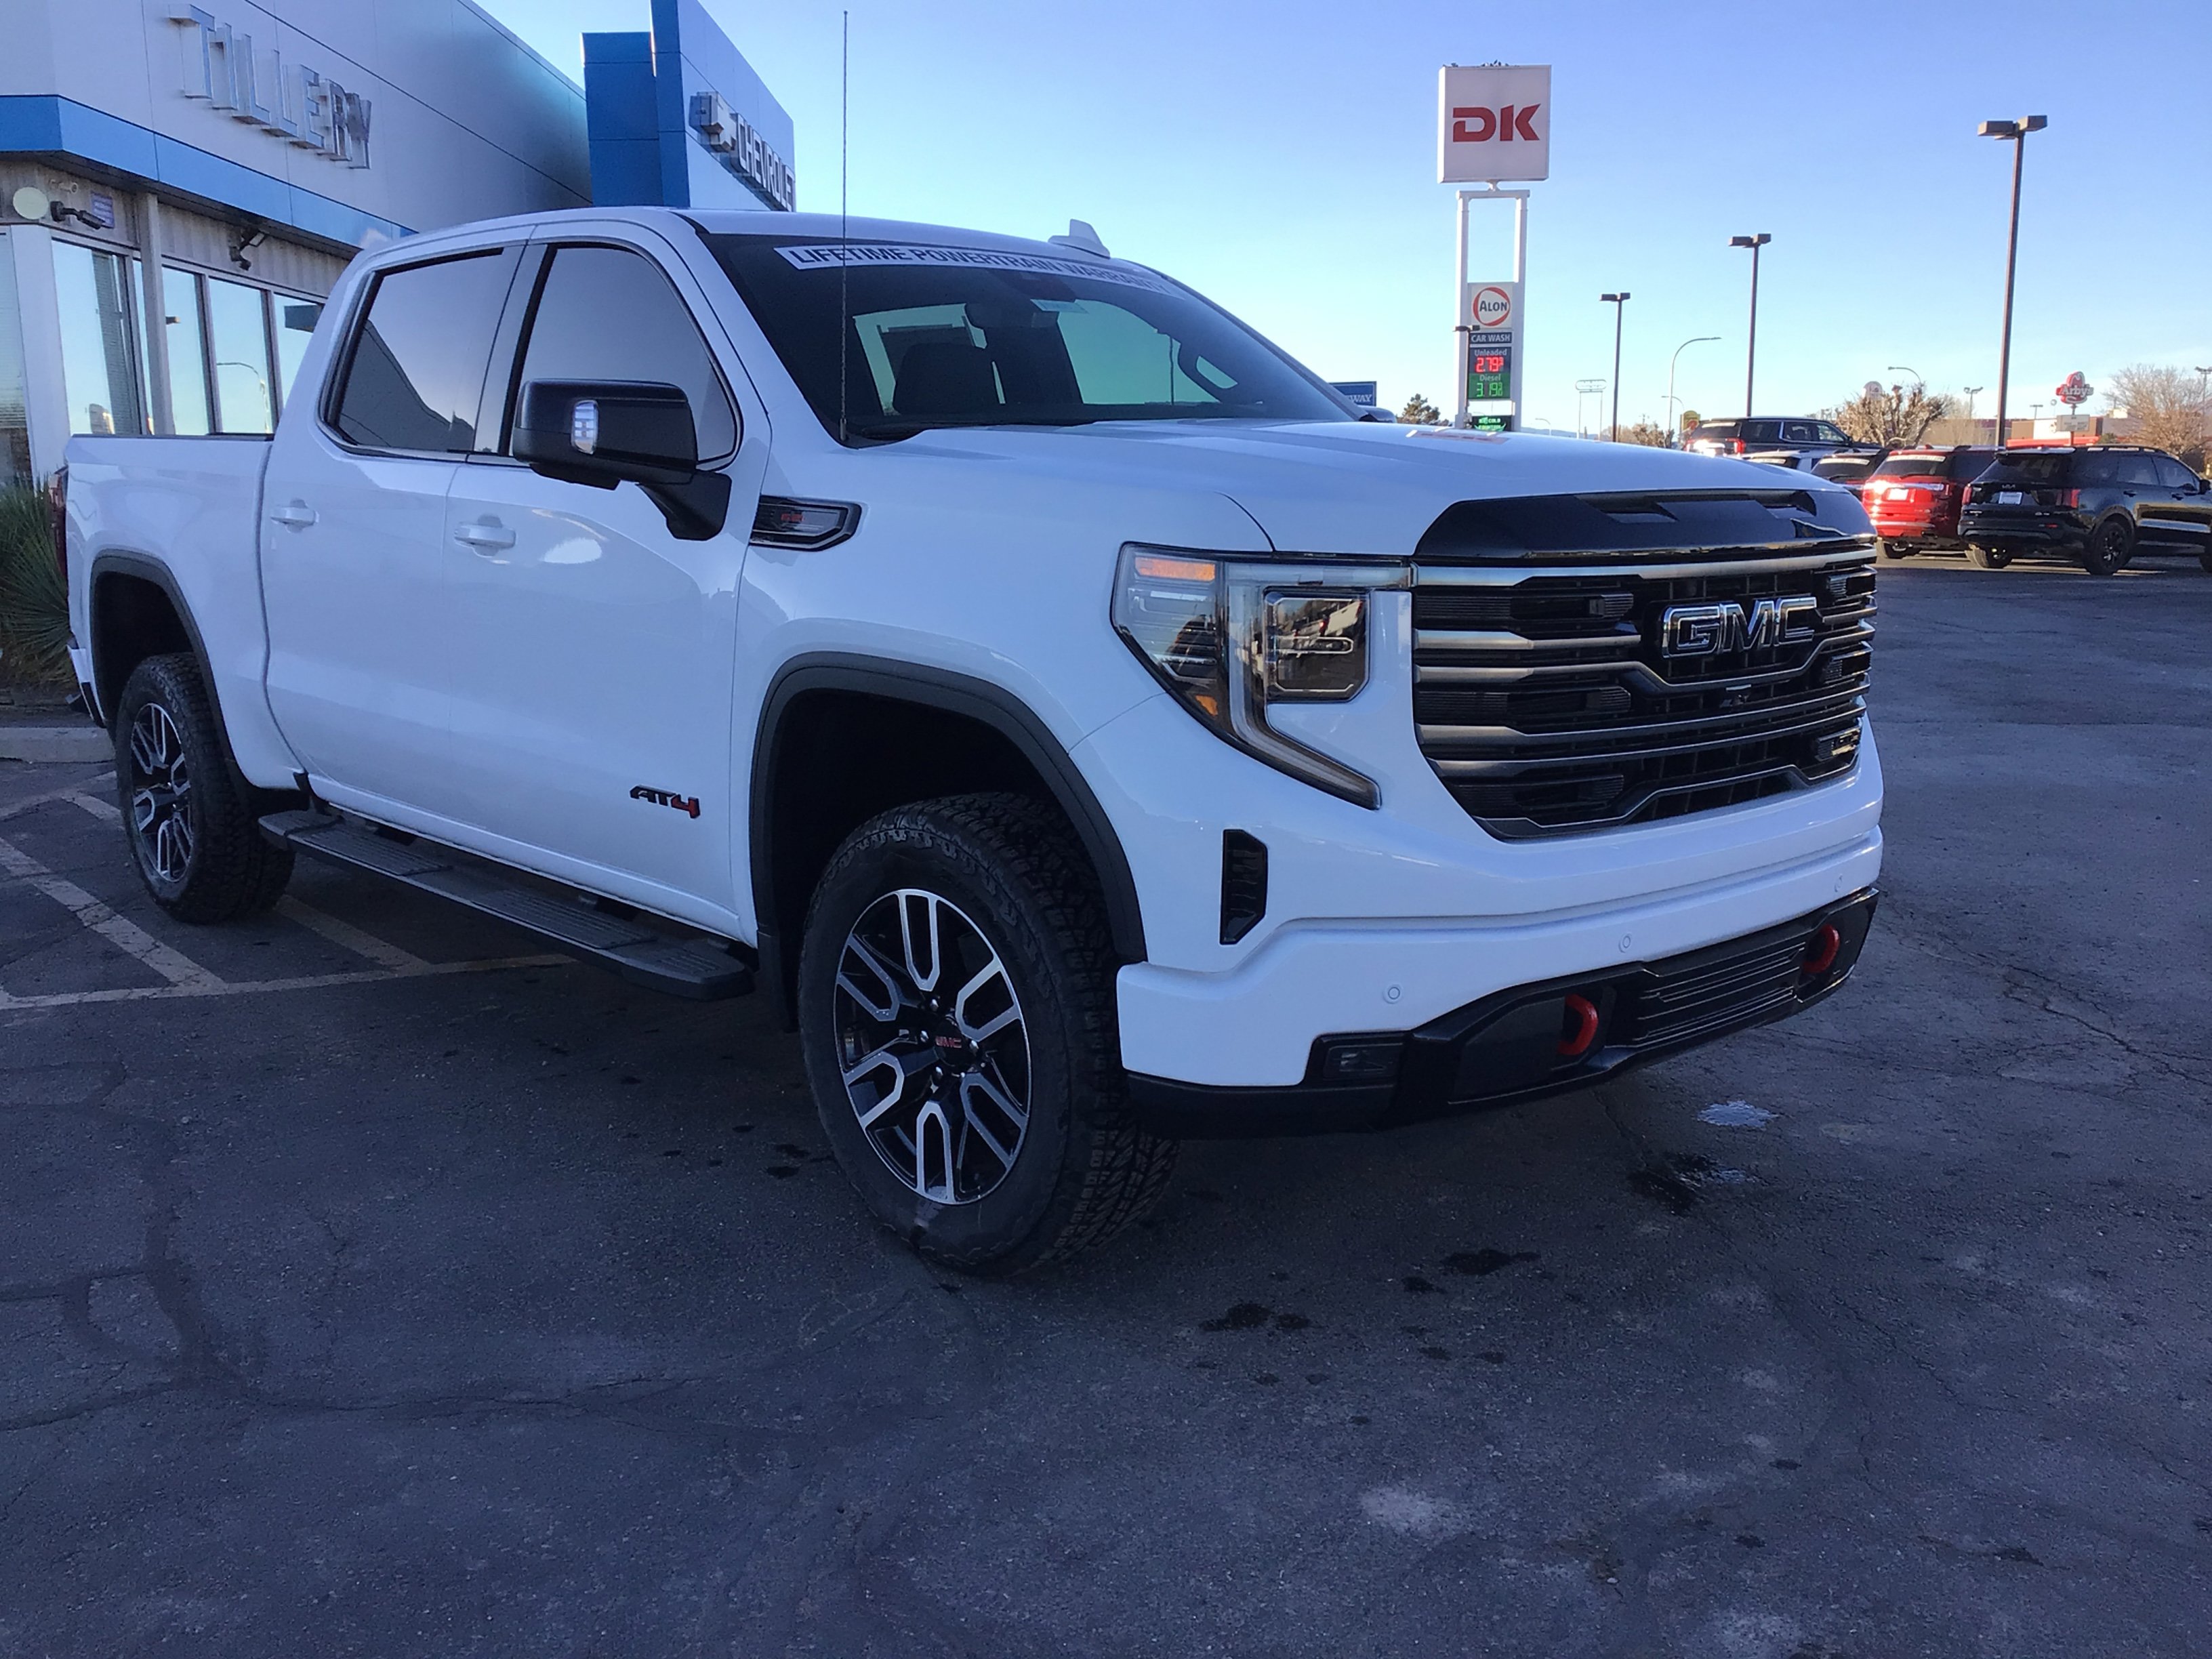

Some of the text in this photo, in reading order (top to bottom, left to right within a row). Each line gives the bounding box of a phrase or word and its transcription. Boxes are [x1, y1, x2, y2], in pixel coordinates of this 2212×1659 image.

[168, 3, 372, 169] TILLERY
[1452, 103, 1542, 142] DK
[788, 247, 913, 264] LIFETIME
[909, 248, 1063, 272] POWERTRAIN
[1488, 333, 1511, 342] WASH
[1474, 348, 1508, 356] Unleaded
[1479, 373, 1501, 382] Diesel
[1347, 394, 1372, 403] WAY
[1662, 596, 1818, 658] GMC
[630, 785, 701, 819] AT4
[935, 1036, 962, 1048] GMC
